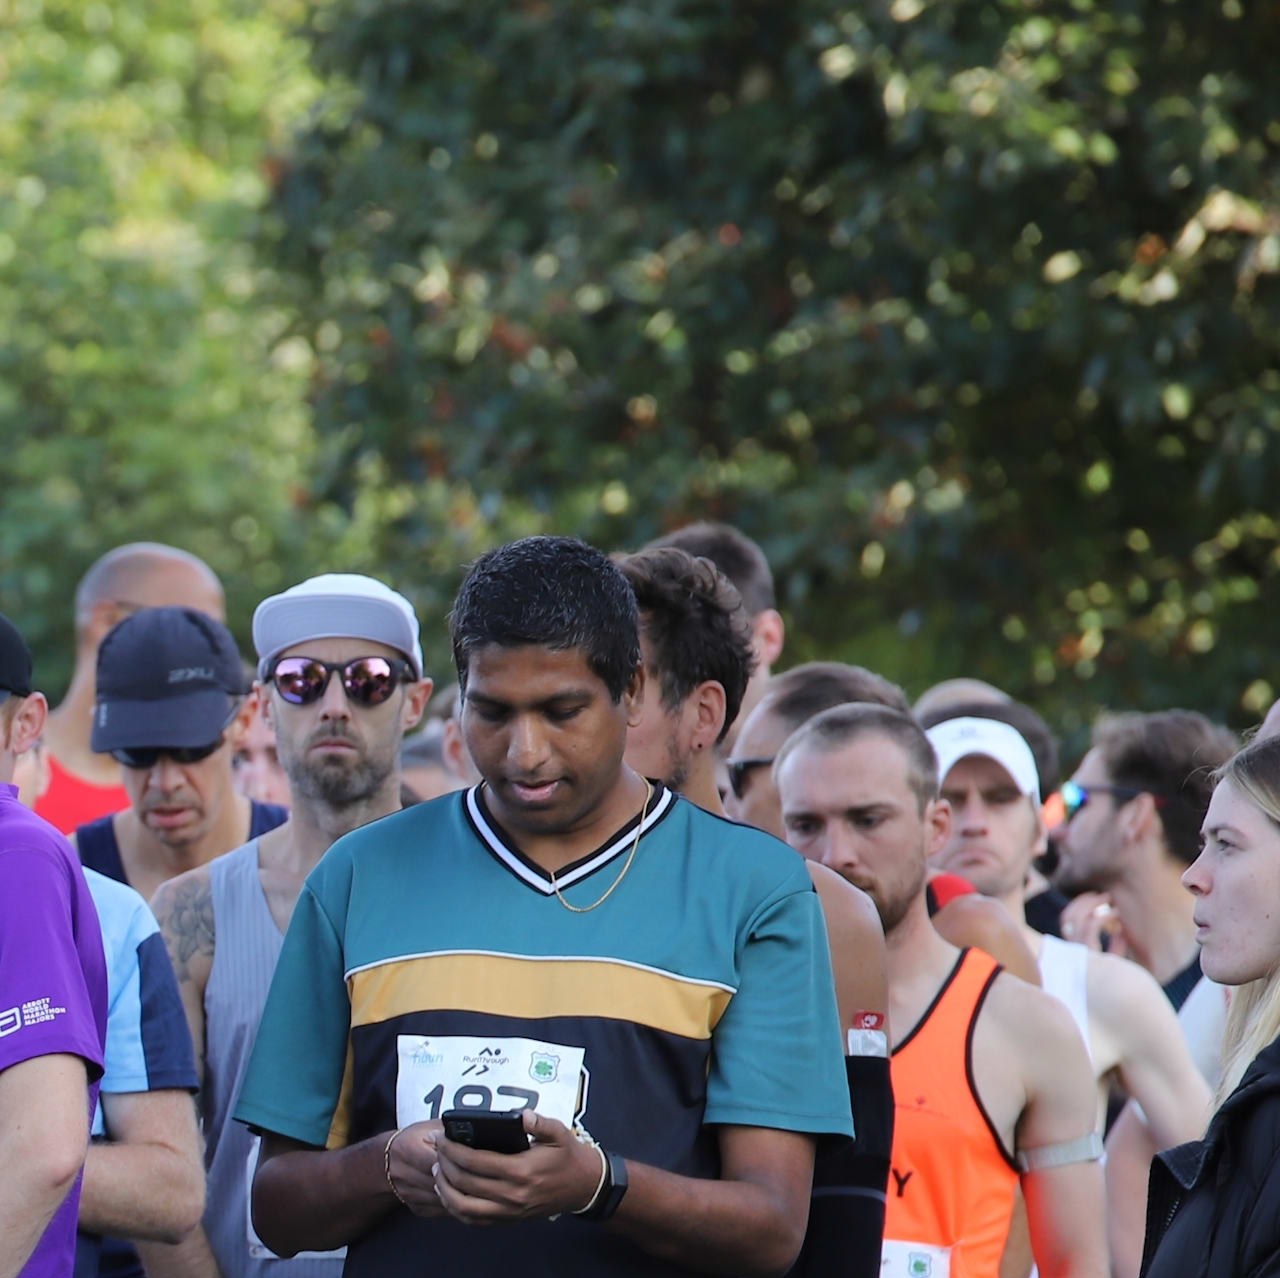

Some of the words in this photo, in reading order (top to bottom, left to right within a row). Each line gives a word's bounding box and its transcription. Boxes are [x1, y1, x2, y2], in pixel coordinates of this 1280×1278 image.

[22, 997, 51, 1009] ABBOTT
[23, 1007, 67, 1020] MARATHON
[24, 1014, 56, 1026] MAJORS
